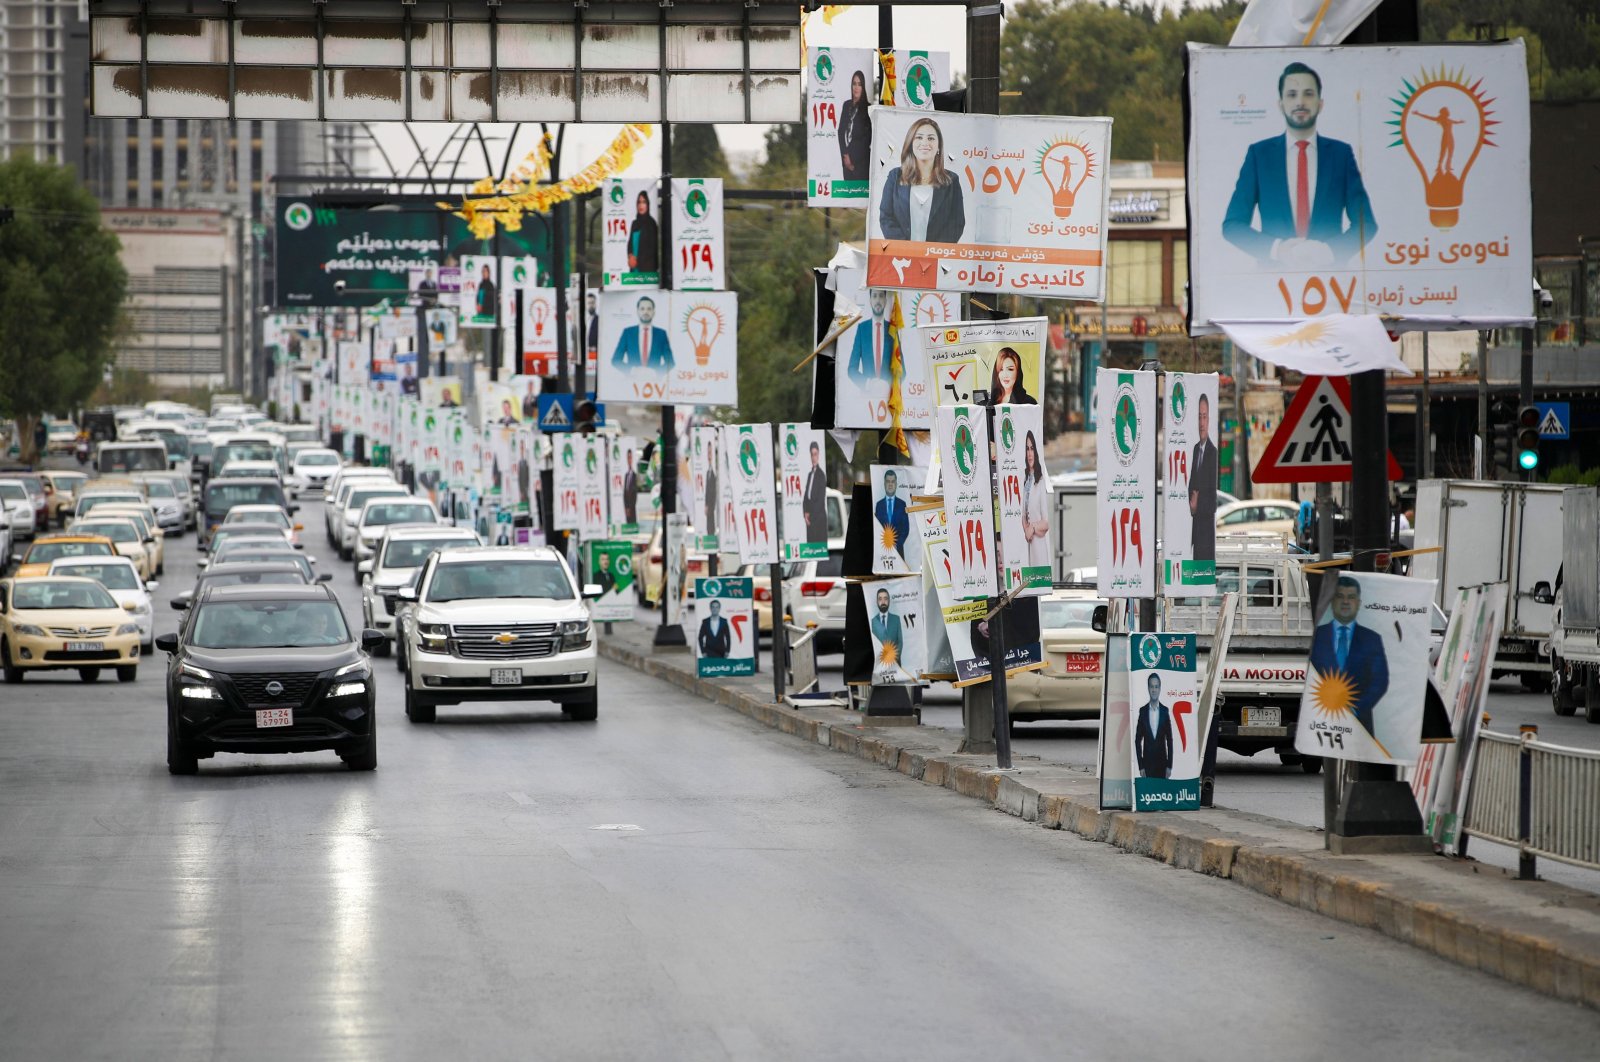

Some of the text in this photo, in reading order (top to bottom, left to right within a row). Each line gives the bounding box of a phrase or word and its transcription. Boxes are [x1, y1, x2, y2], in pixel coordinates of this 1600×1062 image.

[813, 103, 837, 129] ١٢٩
[962, 147, 1025, 161] لیستی ژمارە
[818, 182, 830, 196] ٥٤
[964, 164, 1026, 196] ١٥٧
[608, 219, 628, 237] ١٢٩
[1027, 220, 1099, 237] نەوەی نوێ
[681, 243, 714, 273] ١٢٩
[924, 245, 956, 258] عومەر
[959, 247, 1008, 260] فەرەیدون
[1384, 236, 1509, 266] نەوەی نوێ
[891, 257, 912, 285] ٣
[957, 265, 1085, 290] کاندیدی ژمارە
[1278, 275, 1458, 315] لیستی ژمارە ١٥٧
[932, 348, 977, 361] کاندیدی ژمارە
[633, 382, 667, 400] ١٥٧
[944, 384, 968, 402] ٦٠
[868, 399, 888, 424] ١٥
[1168, 450, 1188, 487] ١٢٩
[786, 475, 802, 499] ١٢٩
[1003, 475, 1021, 506] ١٢٩
[586, 498, 602, 526] ١٢٩
[744, 508, 768, 546] ١٢٩
[1111, 508, 1143, 569] ١٢٩
[958, 519, 987, 571] ١٢٩
[883, 560, 894, 570] ١٦٩
[730, 615, 748, 644] ٢
[904, 613, 916, 630] ١٣
[1394, 620, 1402, 643] ١
[1166, 636, 1187, 650] لیستی
[1004, 650, 1016, 660] شە
[1170, 654, 1187, 669] ١٢٩
[1220, 668, 1240, 680] IA
[1172, 700, 1193, 754] ٢
[1316, 731, 1344, 751] ١٦٩
[1140, 788, 1197, 806] سالار مەحمود
